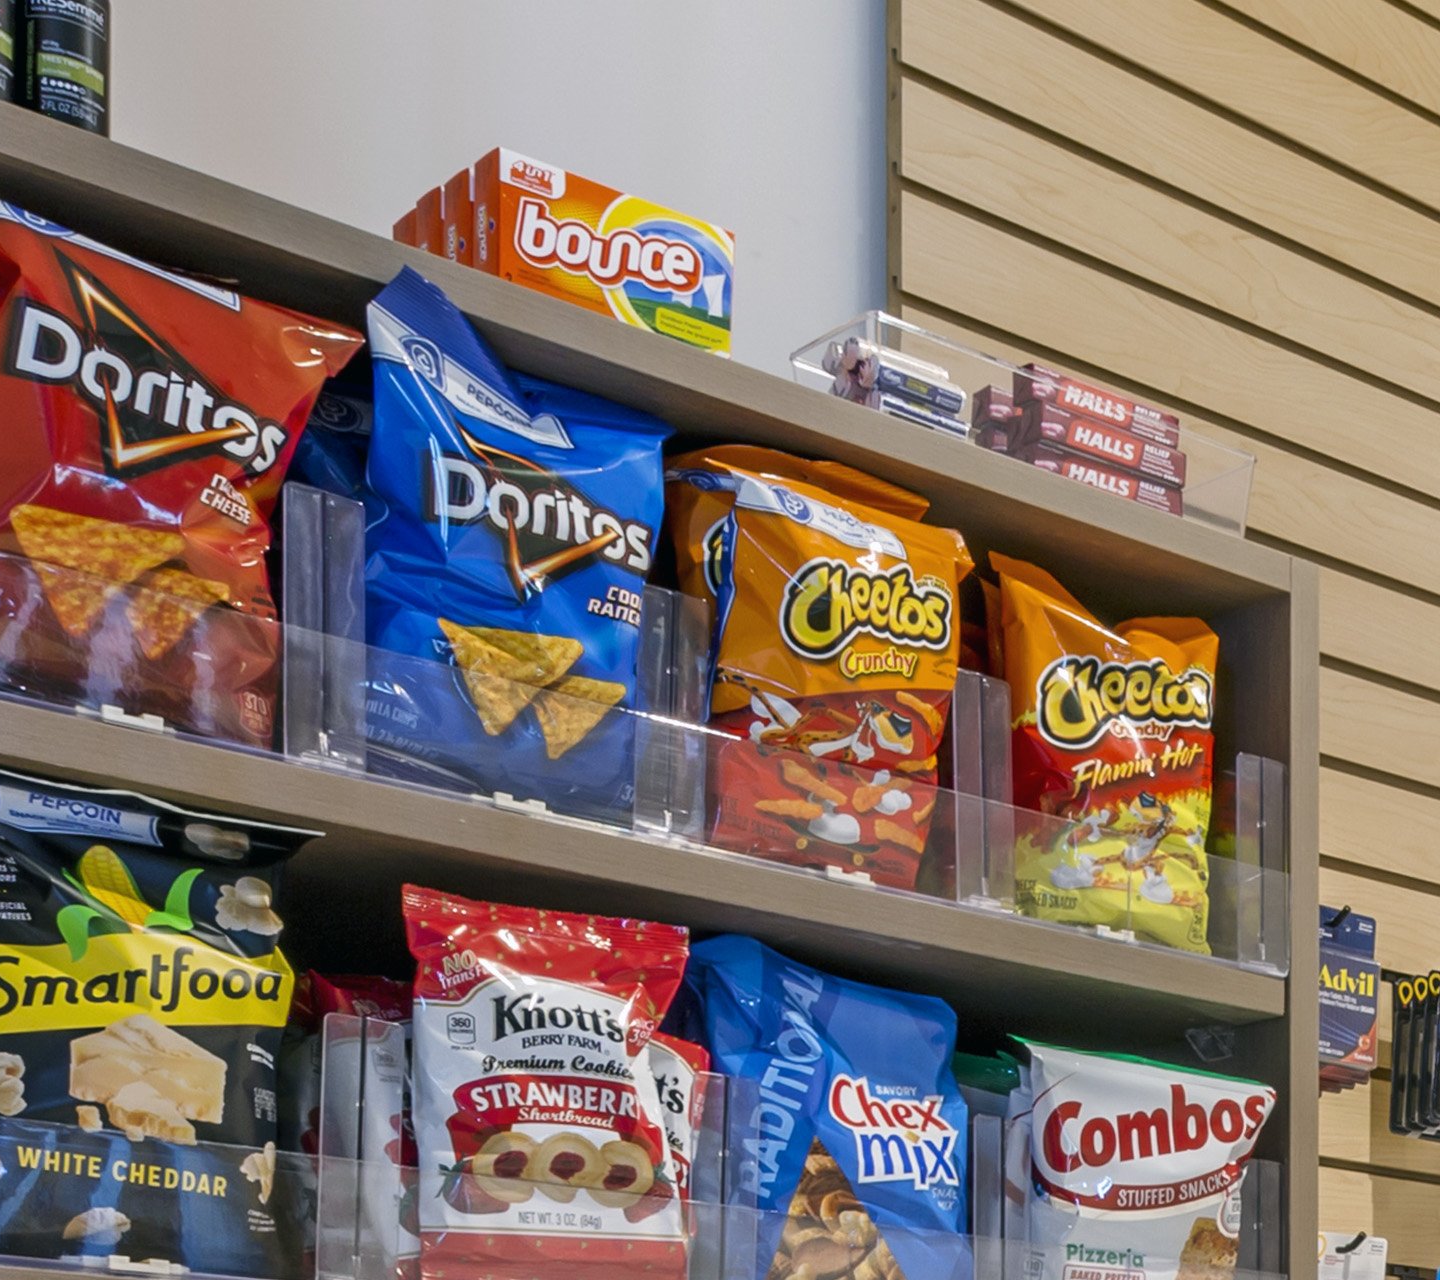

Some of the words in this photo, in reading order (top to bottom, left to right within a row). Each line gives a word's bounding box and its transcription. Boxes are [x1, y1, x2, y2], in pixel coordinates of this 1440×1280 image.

[517, 199, 699, 290] bounce
[13, 303, 286, 475] Doritos
[1065, 386, 1127, 422] HALLS
[1075, 427, 1134, 460] HALLS
[200, 488, 251, 525] CHEESE
[432, 456, 652, 572] Doritos
[785, 560, 950, 655] Cheetos
[839, 647, 915, 677] Crunchy
[1042, 661, 1212, 746] Cheetos
[442, 950, 476, 974] NO
[1319, 967, 1374, 998] Advil
[491, 994, 624, 1042] Knott's
[521, 1034, 566, 1049] BERRY
[568, 1035, 601, 1052] FARM
[518, 1107, 614, 1128] Shortbread
[833, 1075, 942, 1132] Chex
[1043, 1086, 1266, 1172] Combos
[17, 1145, 101, 1179] WHITE
[111, 1159, 229, 1198] CHEDDAR
[1116, 1183, 1175, 1208] STUFFED
[1179, 1171, 1230, 1199] SNACKS
[1065, 1243, 1145, 1269] Pizzeria
